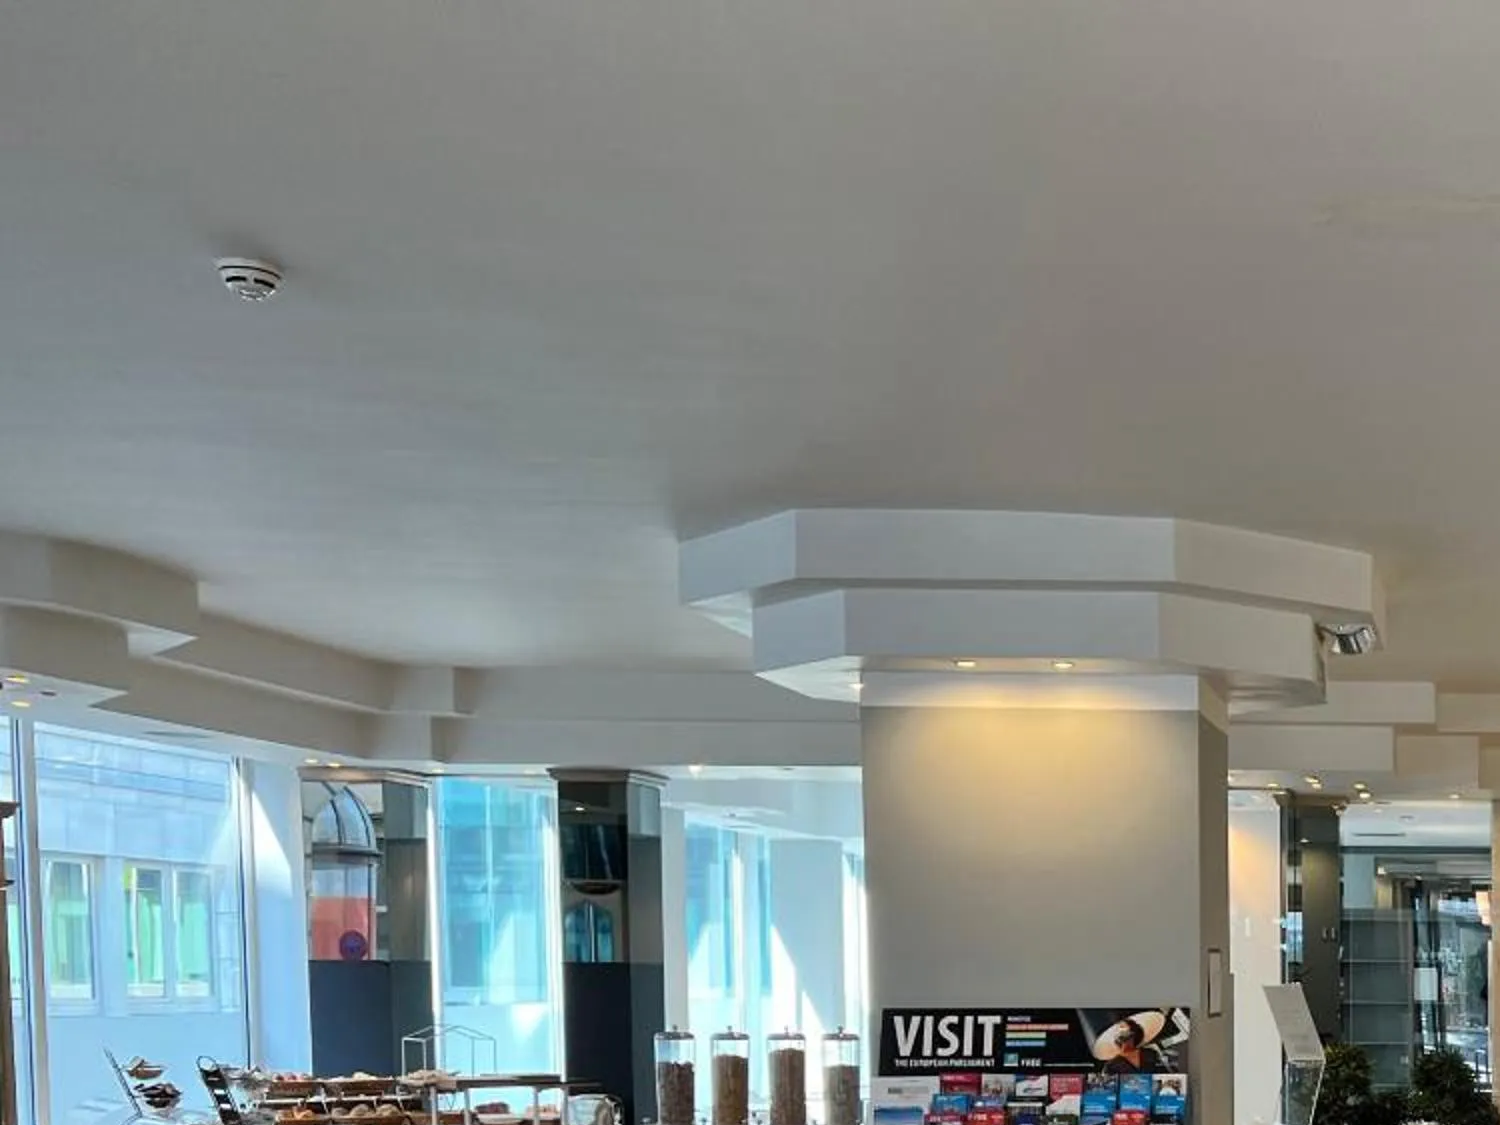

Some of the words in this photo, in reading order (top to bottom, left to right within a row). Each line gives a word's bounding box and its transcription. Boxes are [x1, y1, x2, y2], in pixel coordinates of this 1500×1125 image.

[893, 1015, 1001, 1057] VISIT
[895, 1058, 908, 1067] THE
[909, 1058, 949, 1067] EUROPEAN
